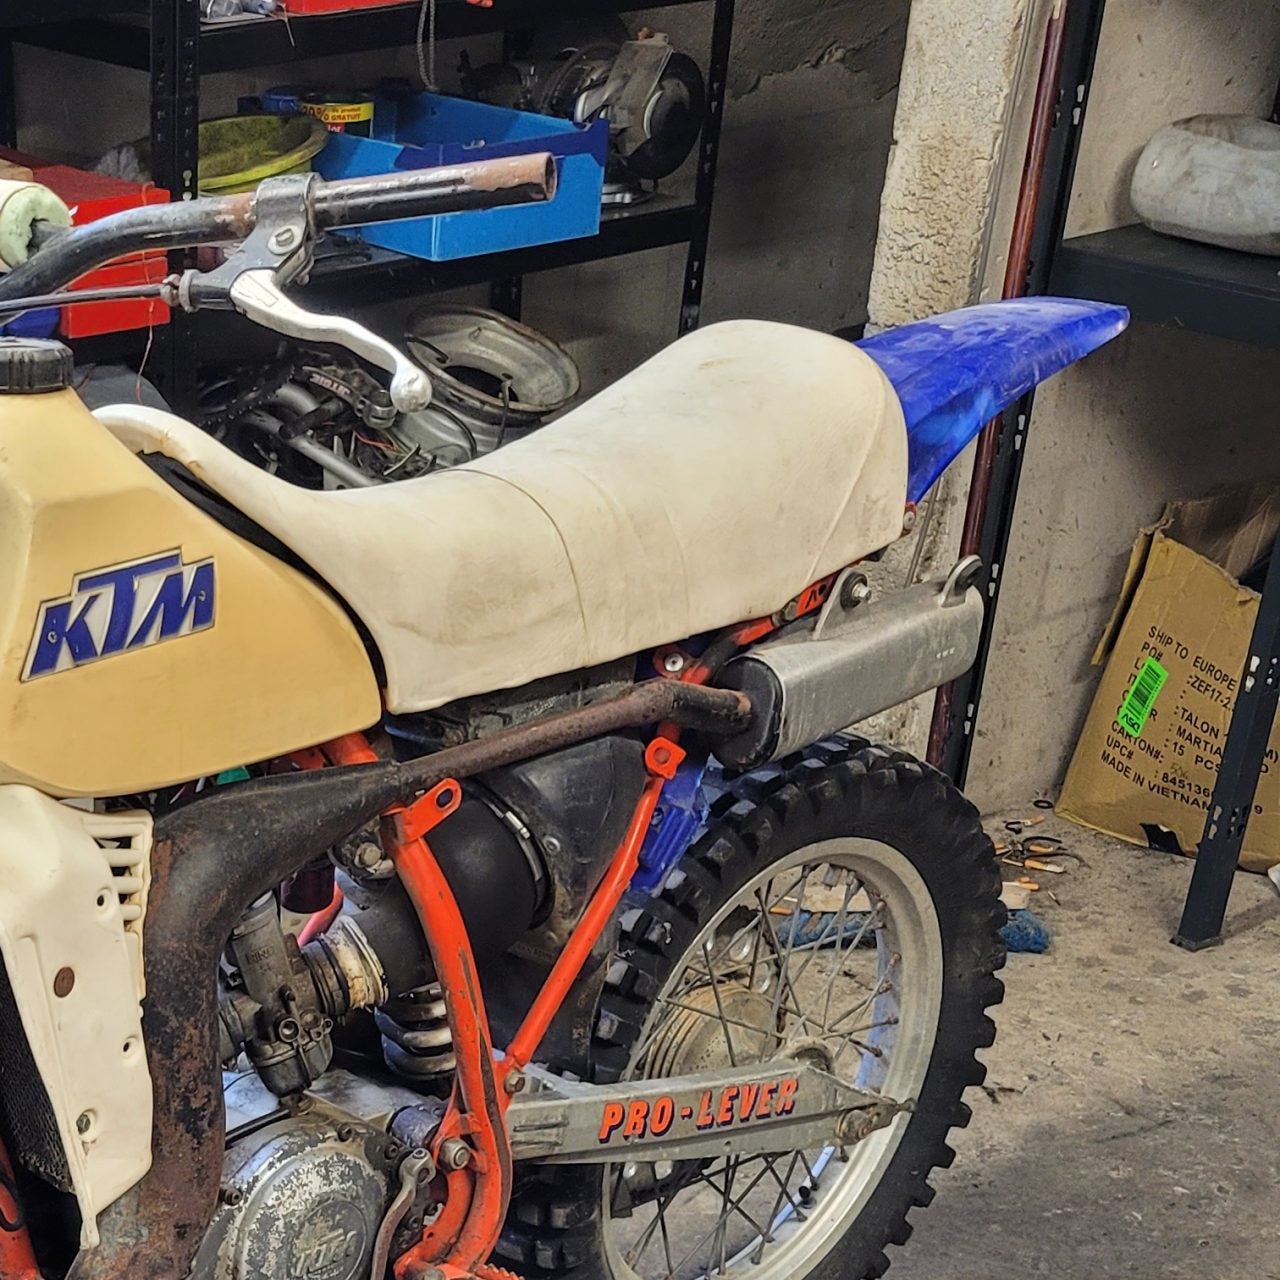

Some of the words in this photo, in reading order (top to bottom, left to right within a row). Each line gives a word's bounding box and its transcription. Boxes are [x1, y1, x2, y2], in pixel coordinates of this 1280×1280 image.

[29, 553, 215, 677] KTM
[1148, 625, 1173, 647] SHIP
[1176, 641, 1189, 660] TO
[1192, 655, 1238, 692] EUROPE
[1106, 734, 1134, 761] UPC#
[1172, 741, 1185, 757] 15
[1101, 749, 1132, 779] MADE
[1132, 771, 1146, 788] IN
